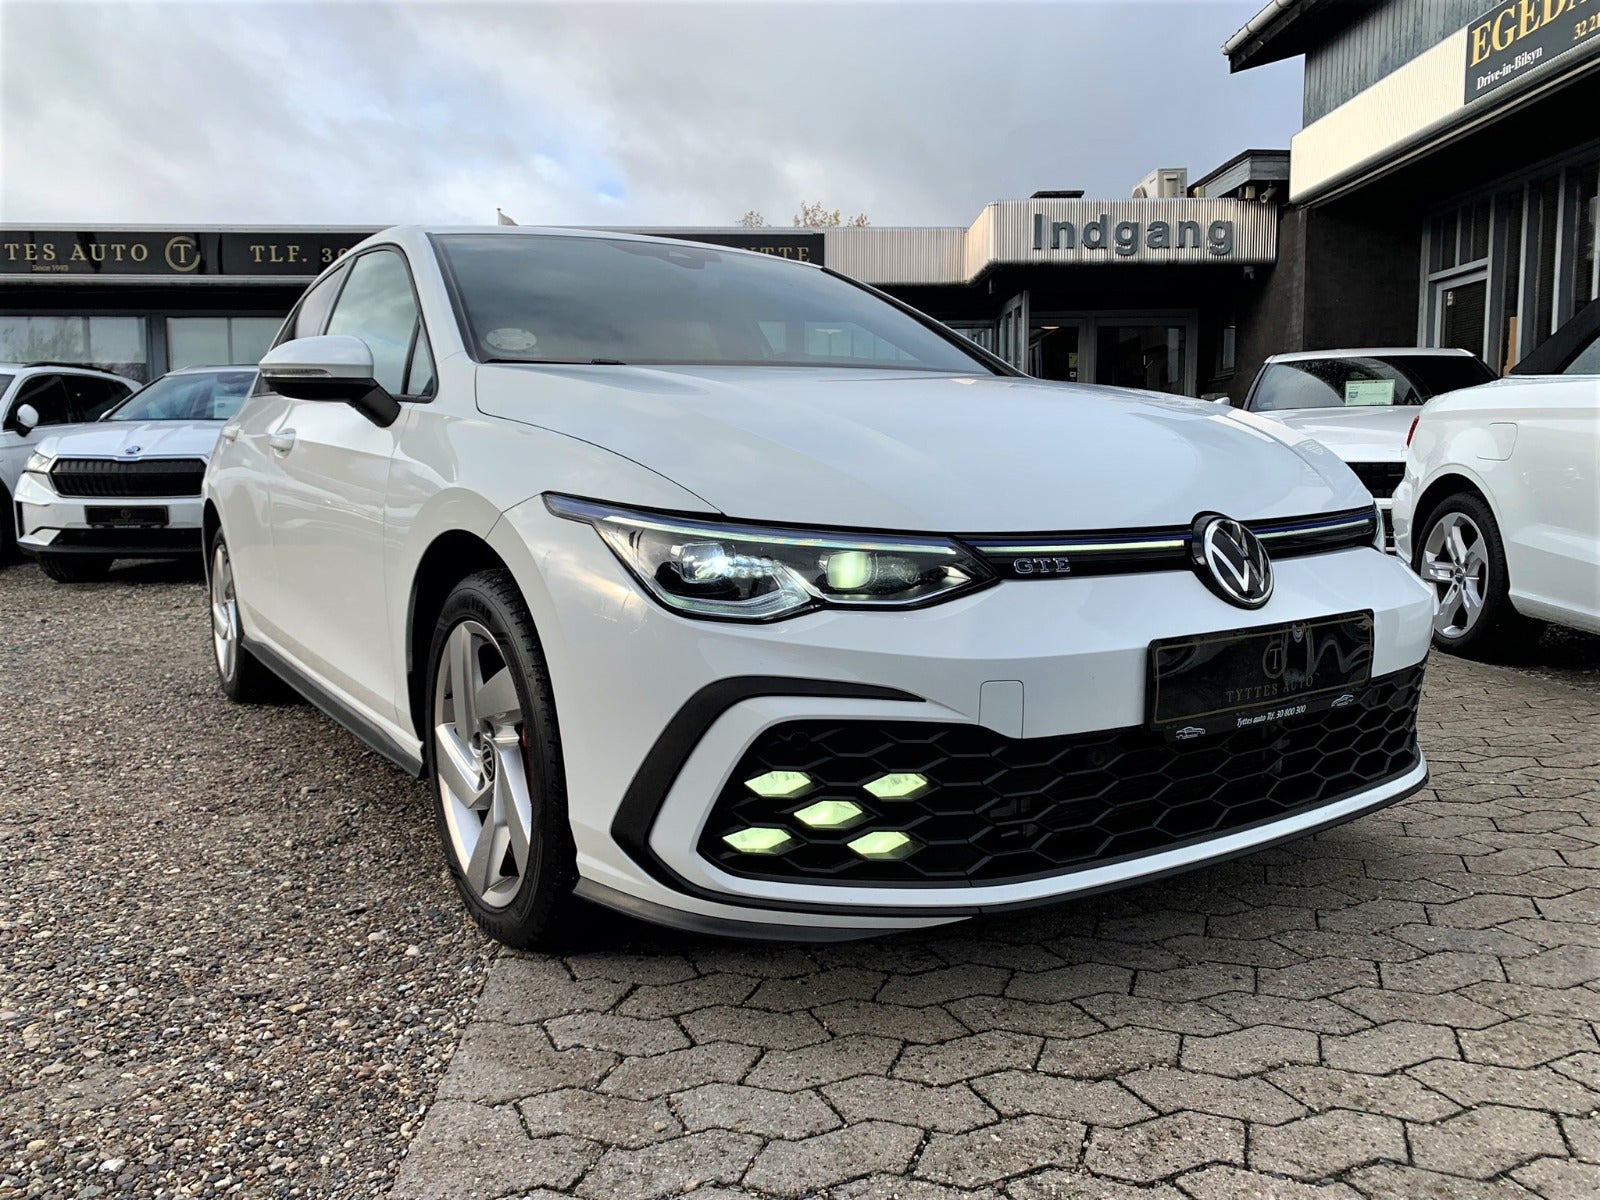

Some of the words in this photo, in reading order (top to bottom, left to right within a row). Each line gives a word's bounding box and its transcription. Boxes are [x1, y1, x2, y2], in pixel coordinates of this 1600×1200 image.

[1470, 0, 1587, 68] EGED
[1574, 20, 1587, 40] 32
[1476, 47, 1543, 91] Drive-in-Bilsyn
[1033, 213, 1233, 256] Indgang
[4, 243, 56, 261] TES
[70, 243, 148, 261] AUTO
[249, 245, 307, 263] TLF.
[1013, 557, 1071, 574] GTE
[1225, 683, 1279, 703] TYTTES
[1283, 675, 1314, 693] AUTO
[1236, 716, 1253, 728] Tyttes
[1253, 713, 1267, 724] auto
[1276, 708, 1284, 719] 30
[1284, 706, 1296, 718] 800
[1295, 704, 1307, 715] 300
